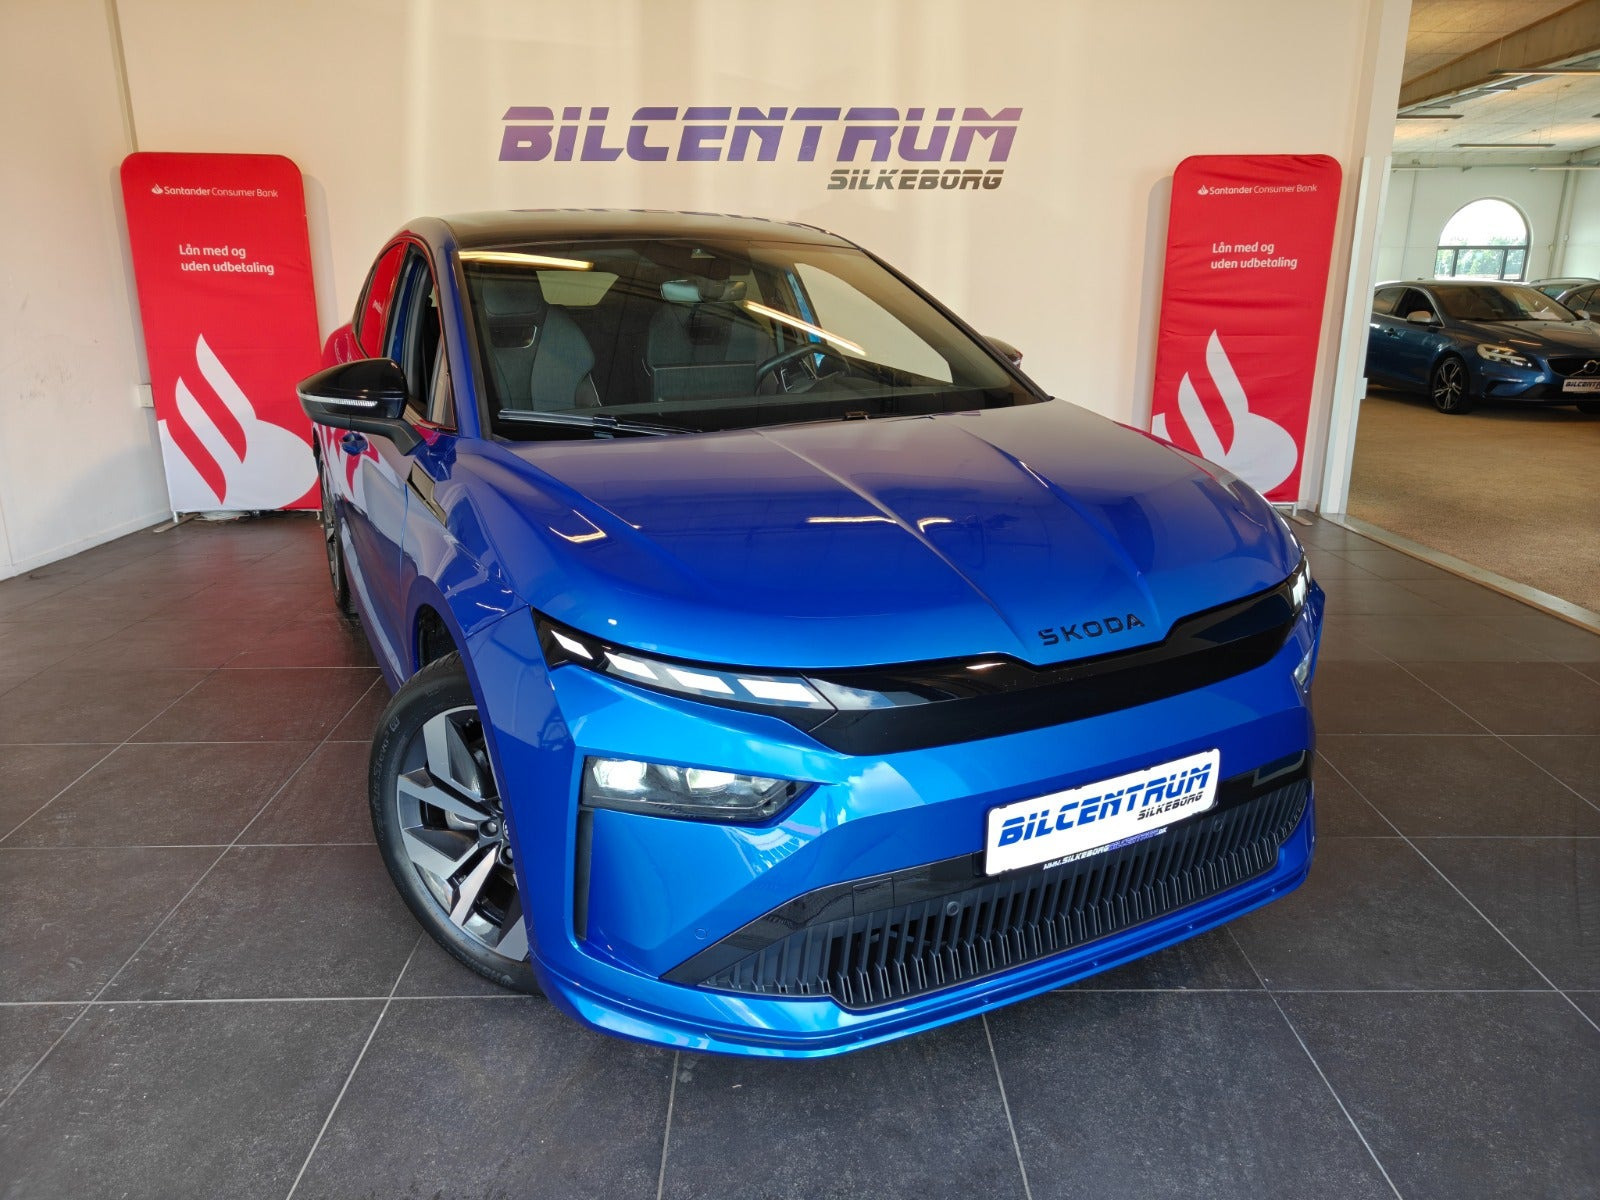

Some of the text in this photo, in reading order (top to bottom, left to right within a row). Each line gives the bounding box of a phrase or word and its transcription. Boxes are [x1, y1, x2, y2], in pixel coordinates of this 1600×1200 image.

[498, 106, 1023, 162] BILCENTRUM
[826, 169, 1004, 190] SILKEBORG
[164, 186, 278, 198] Santander Consumer Bank
[1209, 184, 1318, 195] Santander Consumer Bank
[178, 243, 246, 259] Lån med og
[1212, 241, 1275, 255] Lån med og
[181, 261, 275, 276] uden udbetaling
[1210, 256, 1298, 270] uden udbetaling
[1038, 613, 1145, 646] SKODA
[998, 763, 1212, 847] BILCENTRUM
[1137, 791, 1203, 820] SILKEBORG
